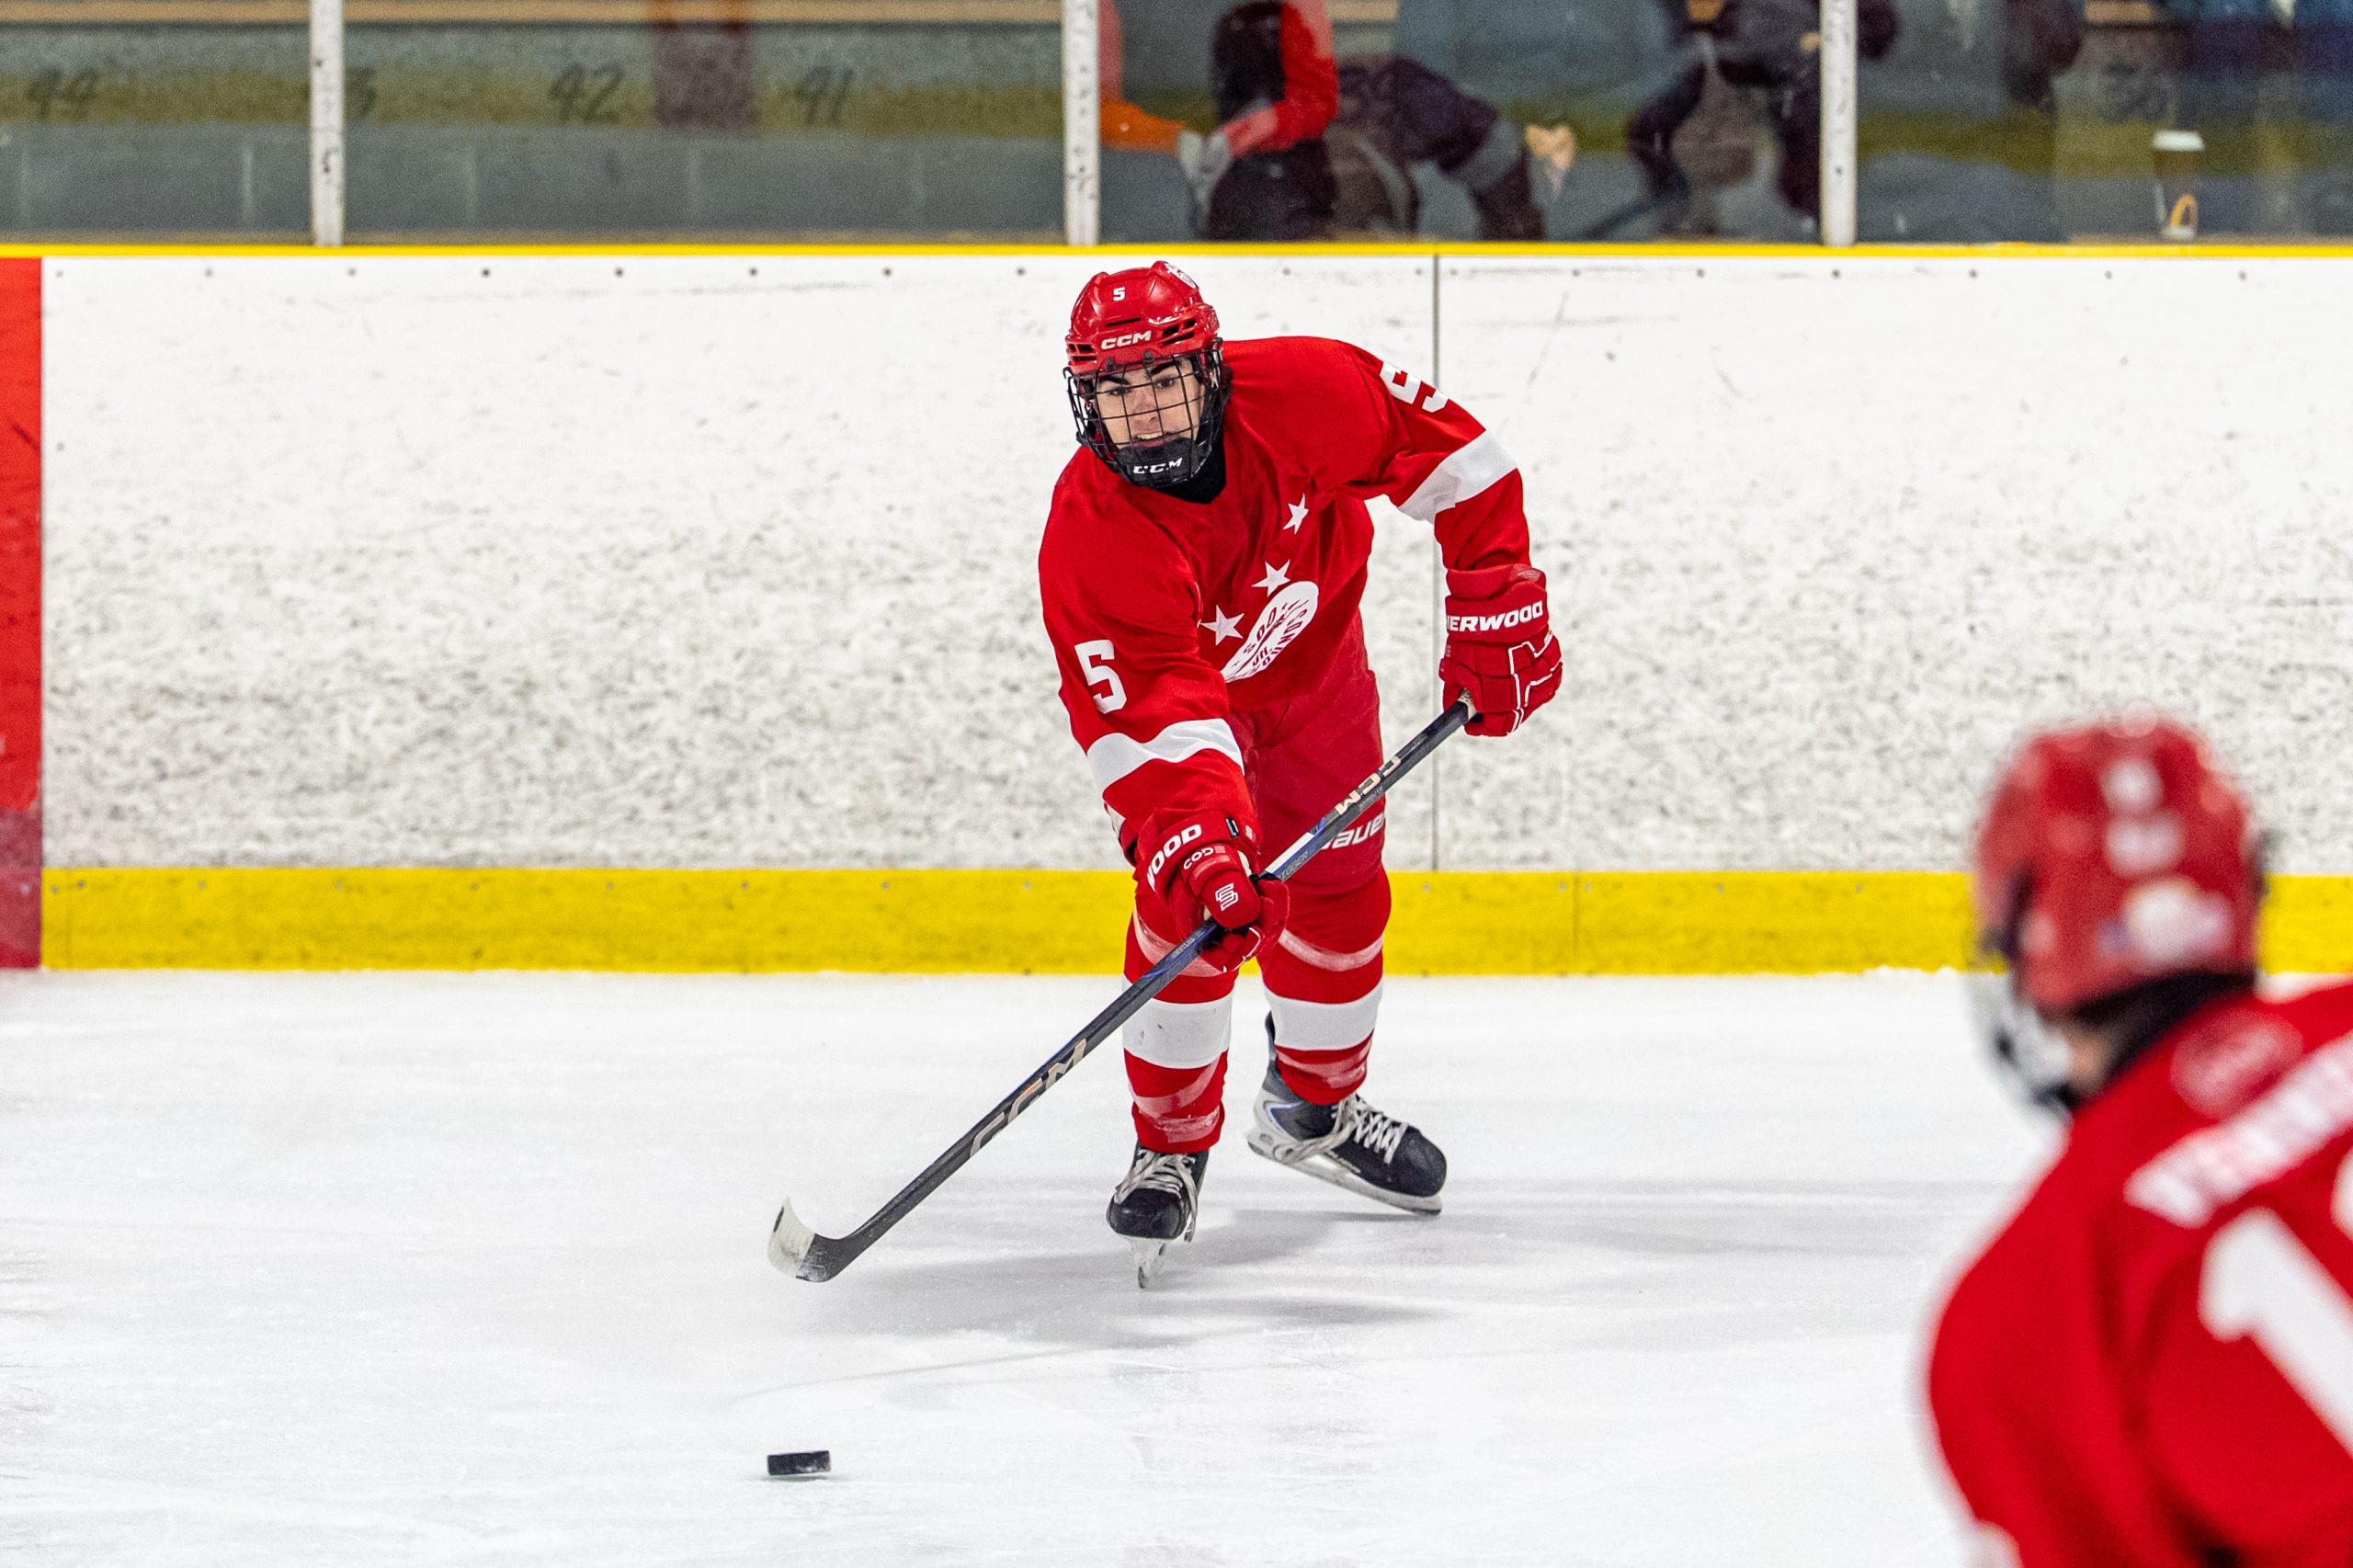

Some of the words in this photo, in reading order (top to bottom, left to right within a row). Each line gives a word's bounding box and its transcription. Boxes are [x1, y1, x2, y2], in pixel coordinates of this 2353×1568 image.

[1112, 286, 1126, 301] 5
[1100, 329, 1153, 350] CCM
[1132, 457, 1183, 474] CCM
[1074, 639, 1128, 715] 5
[1335, 755, 1402, 816] CCM
[1321, 812, 1386, 850] aue
[969, 1037, 1087, 1158] CCM
